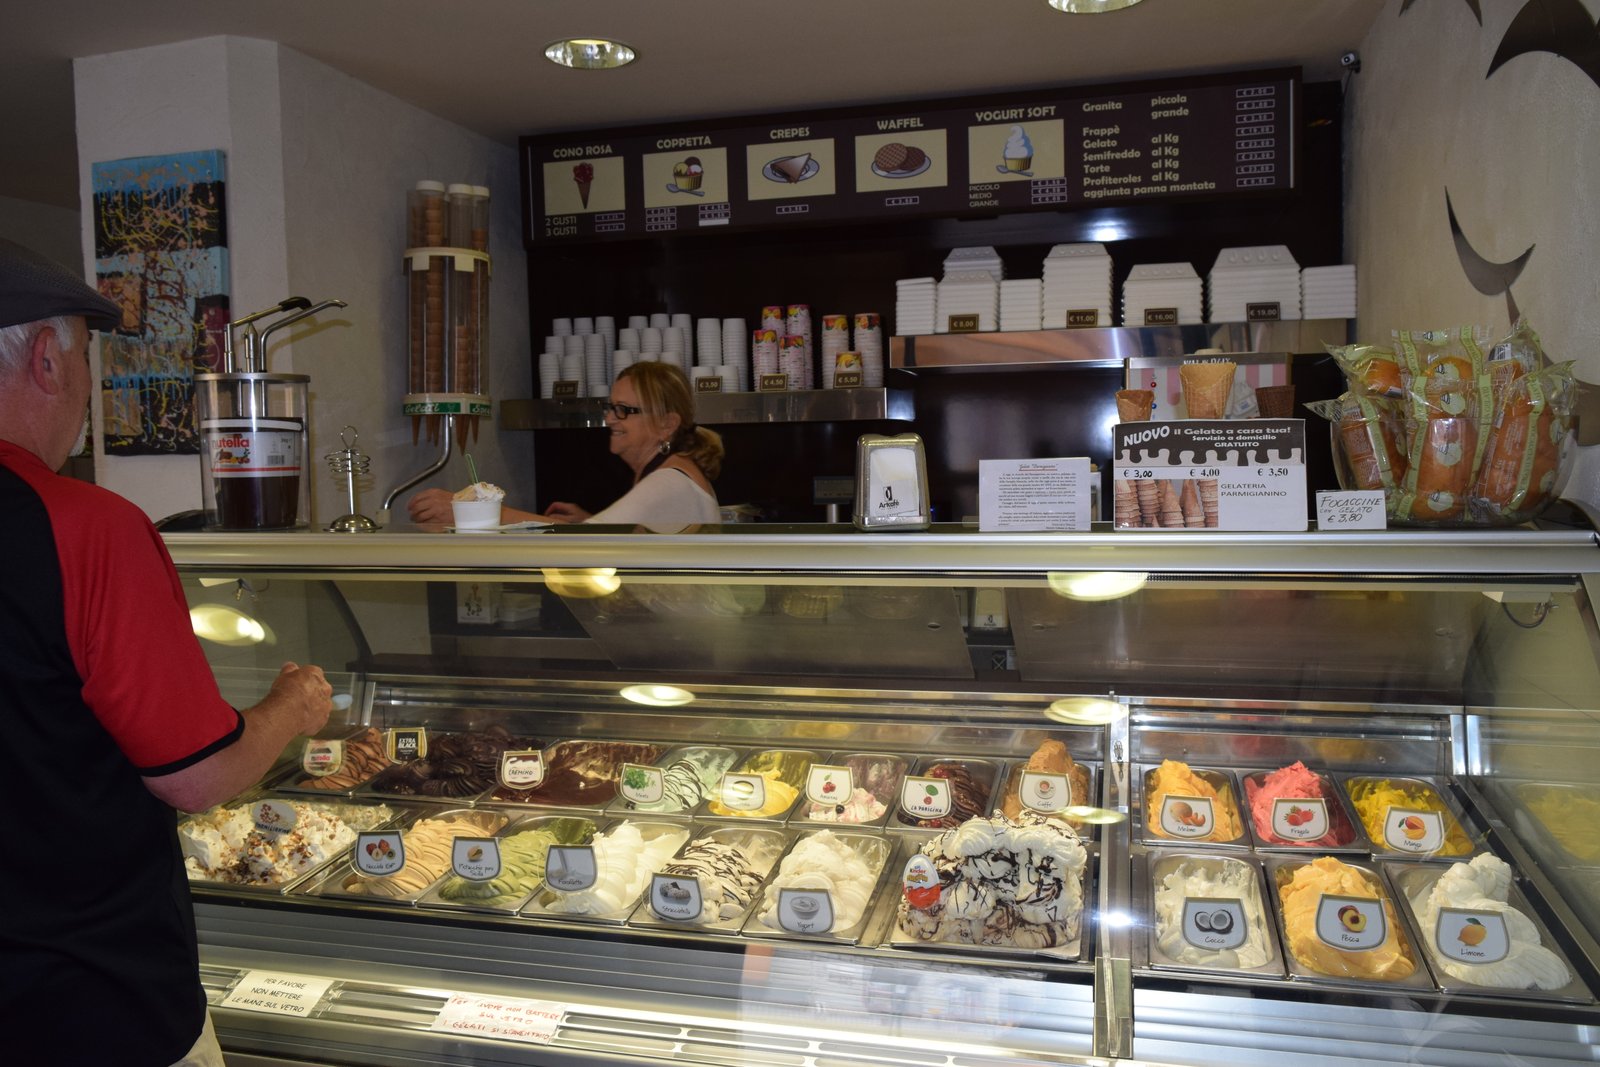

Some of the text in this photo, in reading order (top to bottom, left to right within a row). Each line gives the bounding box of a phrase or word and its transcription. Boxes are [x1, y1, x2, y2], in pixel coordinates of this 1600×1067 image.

[1151, 94, 1187, 107] piccola
[1082, 101, 1122, 113] Granita
[975, 105, 1057, 122] YOGURT SOFT
[1151, 107, 1189, 120] grande
[877, 117, 924, 131] WAFFEL
[770, 127, 811, 140] CREPES
[657, 136, 712, 150] COPPETTA
[1083, 133, 1179, 149] Gelato al Kg
[553, 144, 613, 159] CONO ROSA
[1083, 146, 1180, 162] Semifreddo al Kg
[1083, 158, 1180, 174] Torte al Kg
[1083, 171, 1180, 187] Profiteroles al Kg
[969, 183, 1000, 191] PICCOLO
[1083, 180, 1216, 199] aggiunta panna montata
[969, 199, 999, 208] GRANDE
[546, 215, 578, 226] 2 GUSTI
[546, 226, 578, 237] 3 GUSTI
[212, 436, 250, 448] nutella
[1122, 425, 1171, 447] NUOVO
[1183, 428, 1223, 436] Gelato
[1266, 426, 1291, 434] tua!
[1235, 433, 1277, 441] domicilio
[1134, 469, 1152, 479] 3,00
[1190, 468, 1220, 478] € 4,00
[1257, 467, 1288, 477] € 3,50
[1320, 495, 1383, 508] FOCACCINE
[1338, 506, 1373, 514] GELATO
[1327, 513, 1362, 524] € 3,80
[1204, 935, 1225, 944] Cocco
[1341, 933, 1360, 943] Pesca
[1460, 947, 1485, 957] Limone
[278, 979, 307, 990] FAVORE
[251, 987, 303, 1000] NON METTERE
[244, 997, 265, 1006] MANI
[264, 1001, 278, 1009] SUL
[280, 1003, 305, 1013] VETRO
